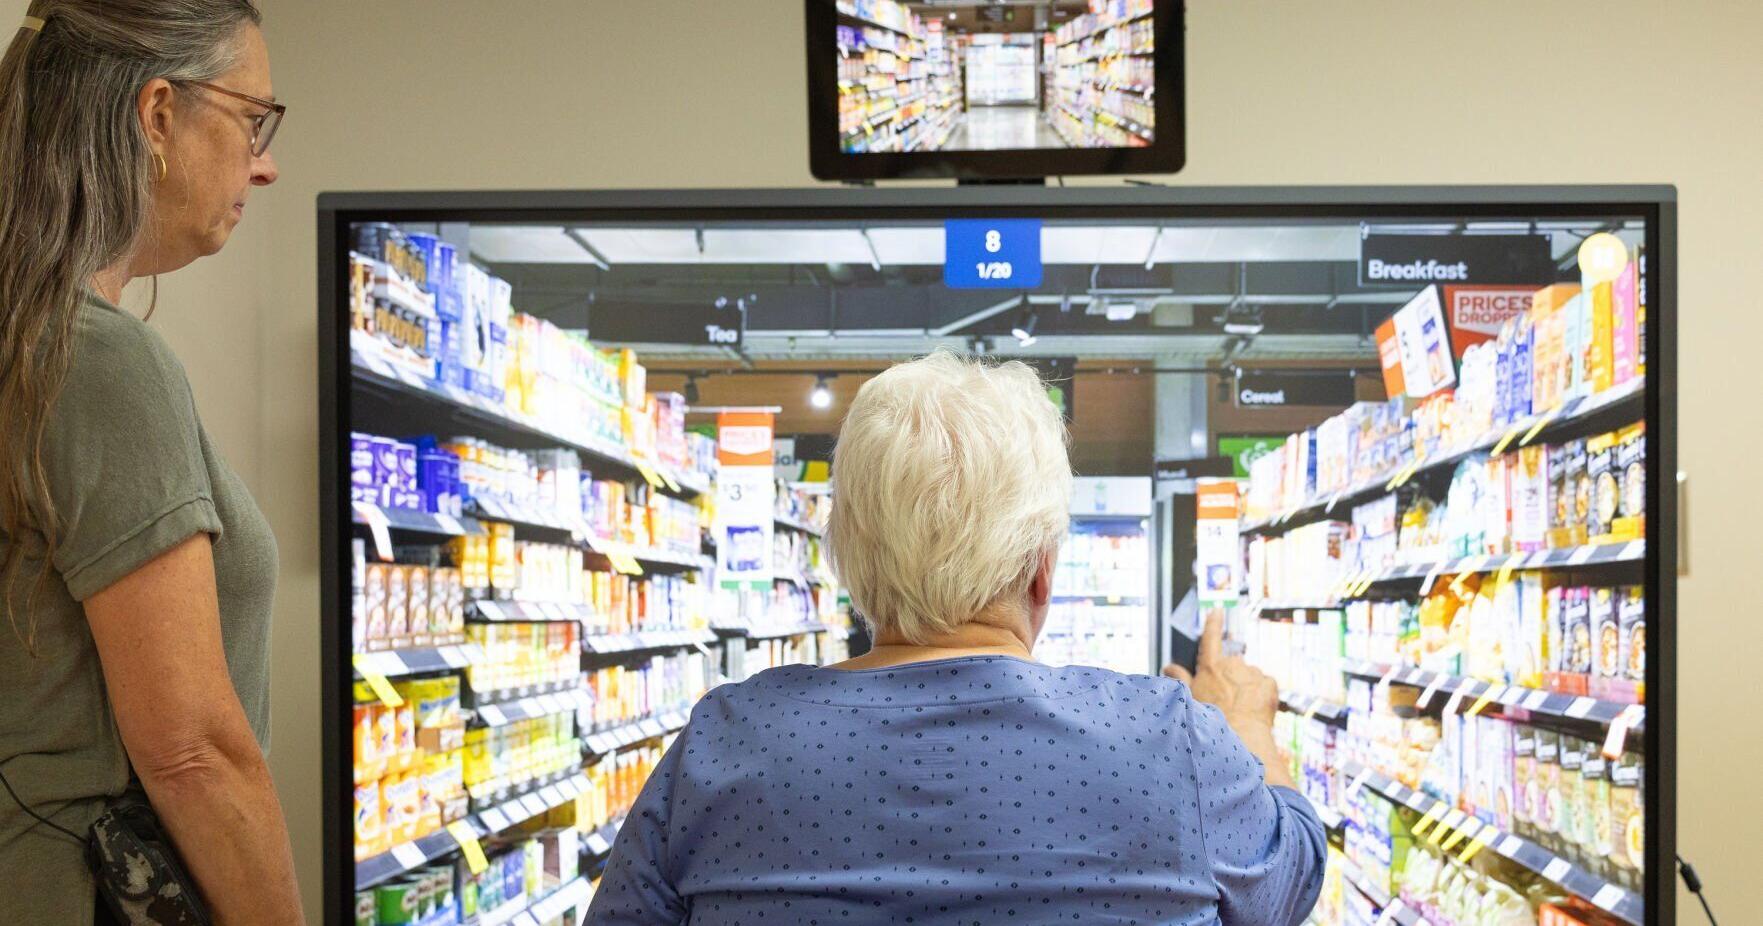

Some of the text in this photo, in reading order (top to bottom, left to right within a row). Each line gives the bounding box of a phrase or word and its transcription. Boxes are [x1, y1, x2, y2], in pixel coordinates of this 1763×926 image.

[986, 230, 1001, 252] 8
[976, 262, 1012, 279] 1/20
[1368, 259, 1468, 280] Breakfast
[1459, 295, 1533, 312] PRICES
[705, 325, 738, 343] Tea
